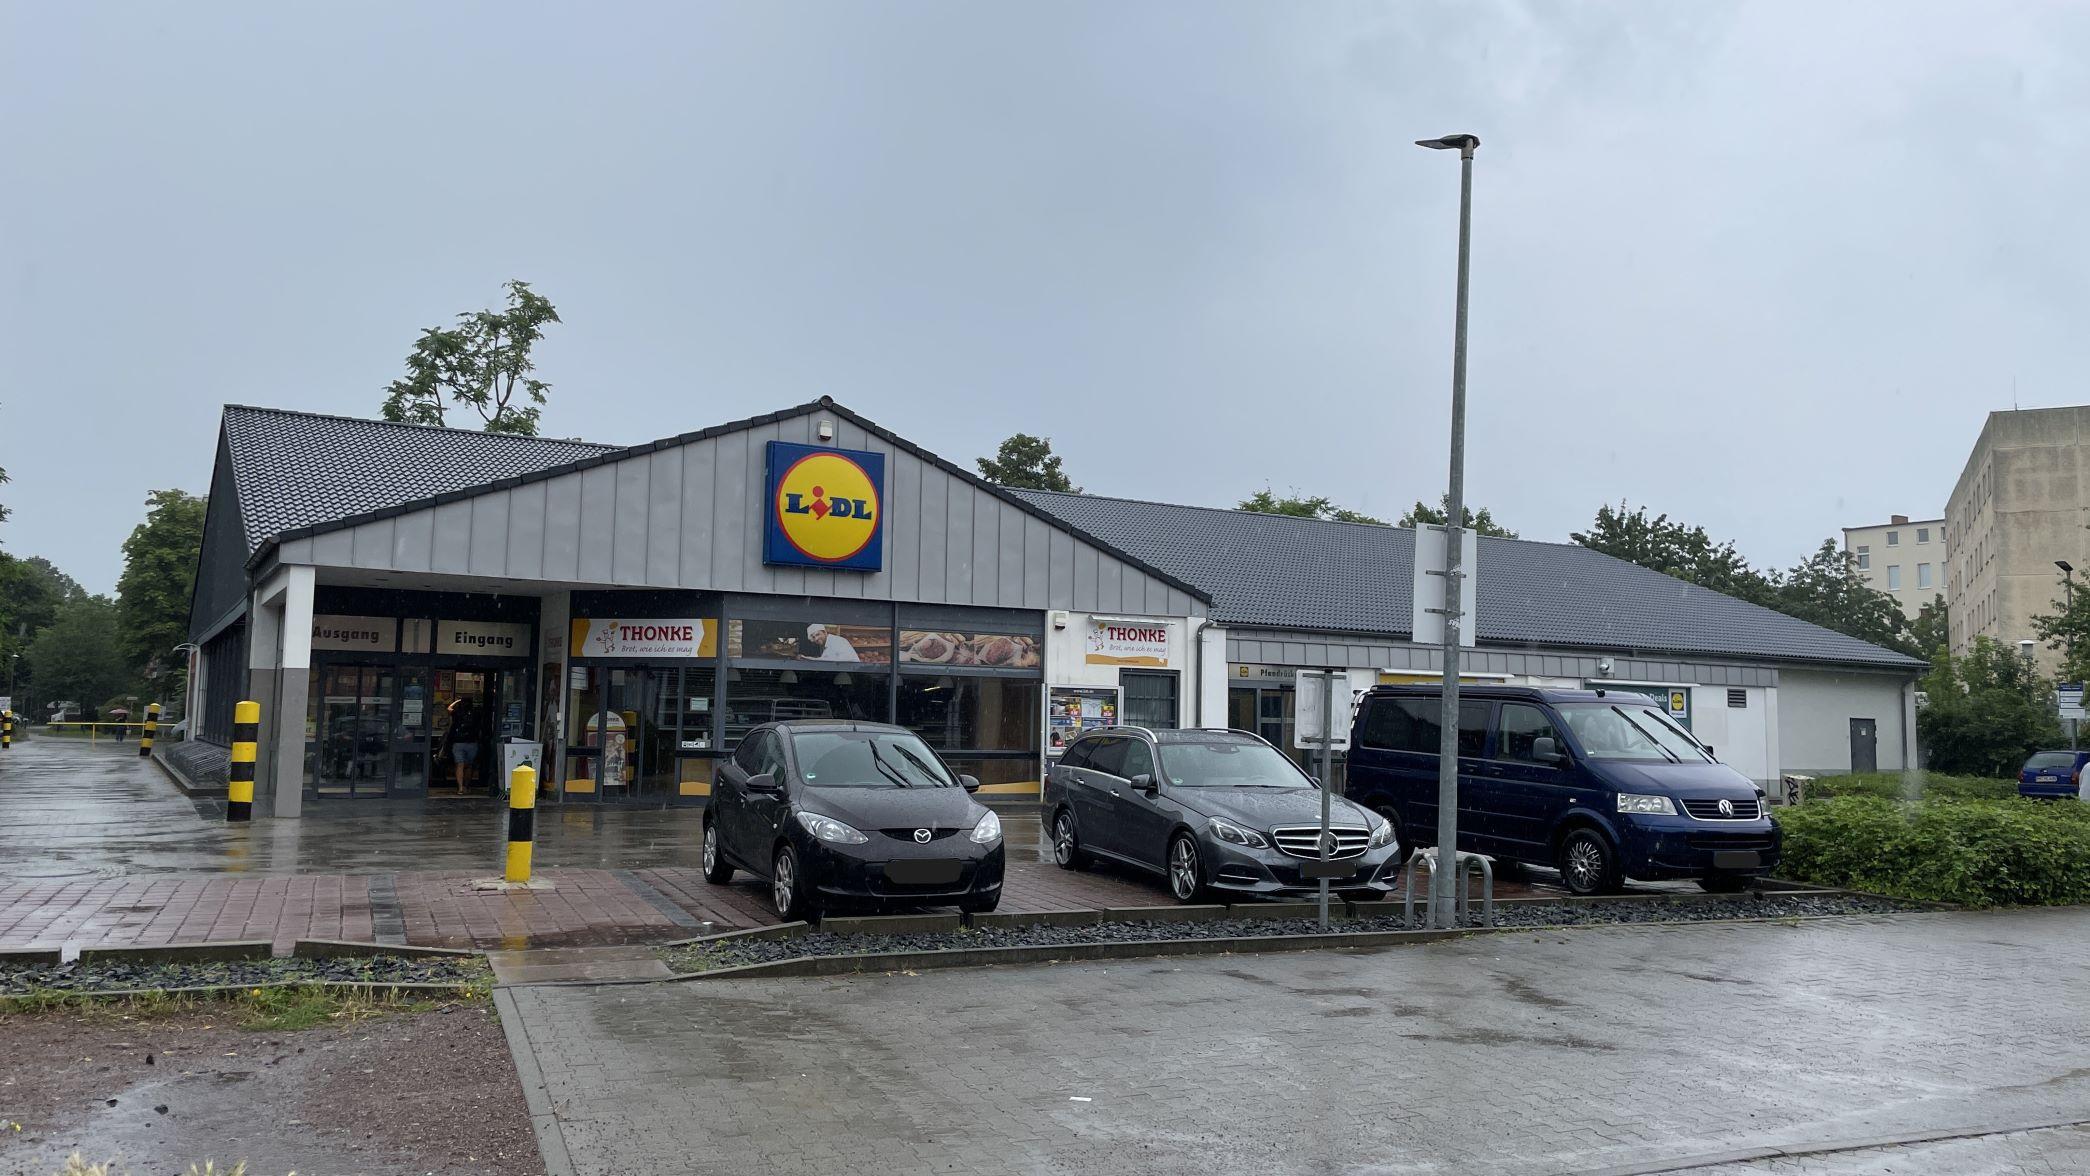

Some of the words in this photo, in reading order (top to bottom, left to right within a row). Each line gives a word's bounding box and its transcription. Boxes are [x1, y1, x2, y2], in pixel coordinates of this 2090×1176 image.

[312, 626, 380, 643] Ausgang
[455, 631, 514, 648] Eingang
[620, 625, 694, 641] THONKE
[1107, 626, 1166, 643] THONKE
